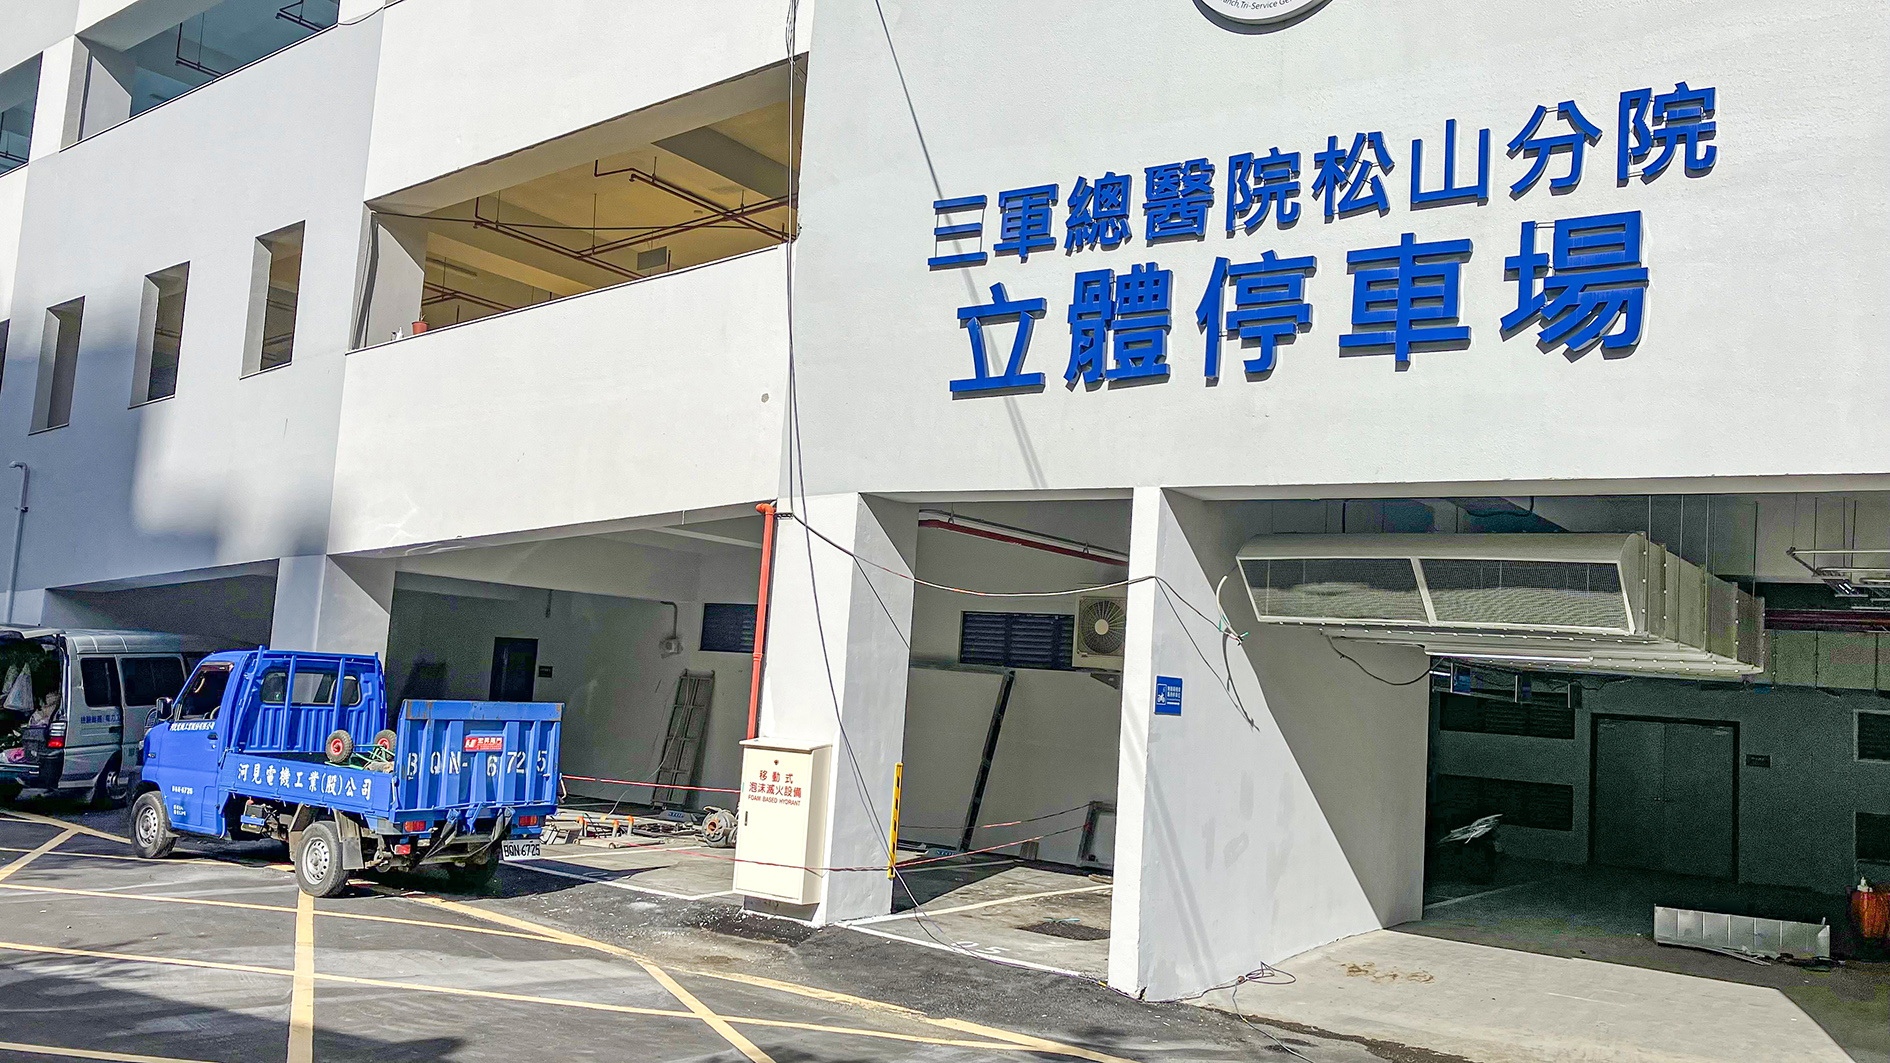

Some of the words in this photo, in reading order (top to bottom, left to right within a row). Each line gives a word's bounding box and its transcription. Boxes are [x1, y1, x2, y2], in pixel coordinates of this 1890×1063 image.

[1240, 1, 1278, 10] Tri-Service
[927, 81, 1718, 272] 三軍總醫院松山分院
[949, 210, 1650, 401] 立體停車場
[237, 762, 373, 801] 河見電機工業(股)公司
[759, 769, 794, 784] 移動式
[748, 781, 802, 798] 泡沫滅火設備
[748, 794, 761, 802] FOAM
[762, 796, 778, 804] BASED
[779, 798, 801, 806] HYDRANT
